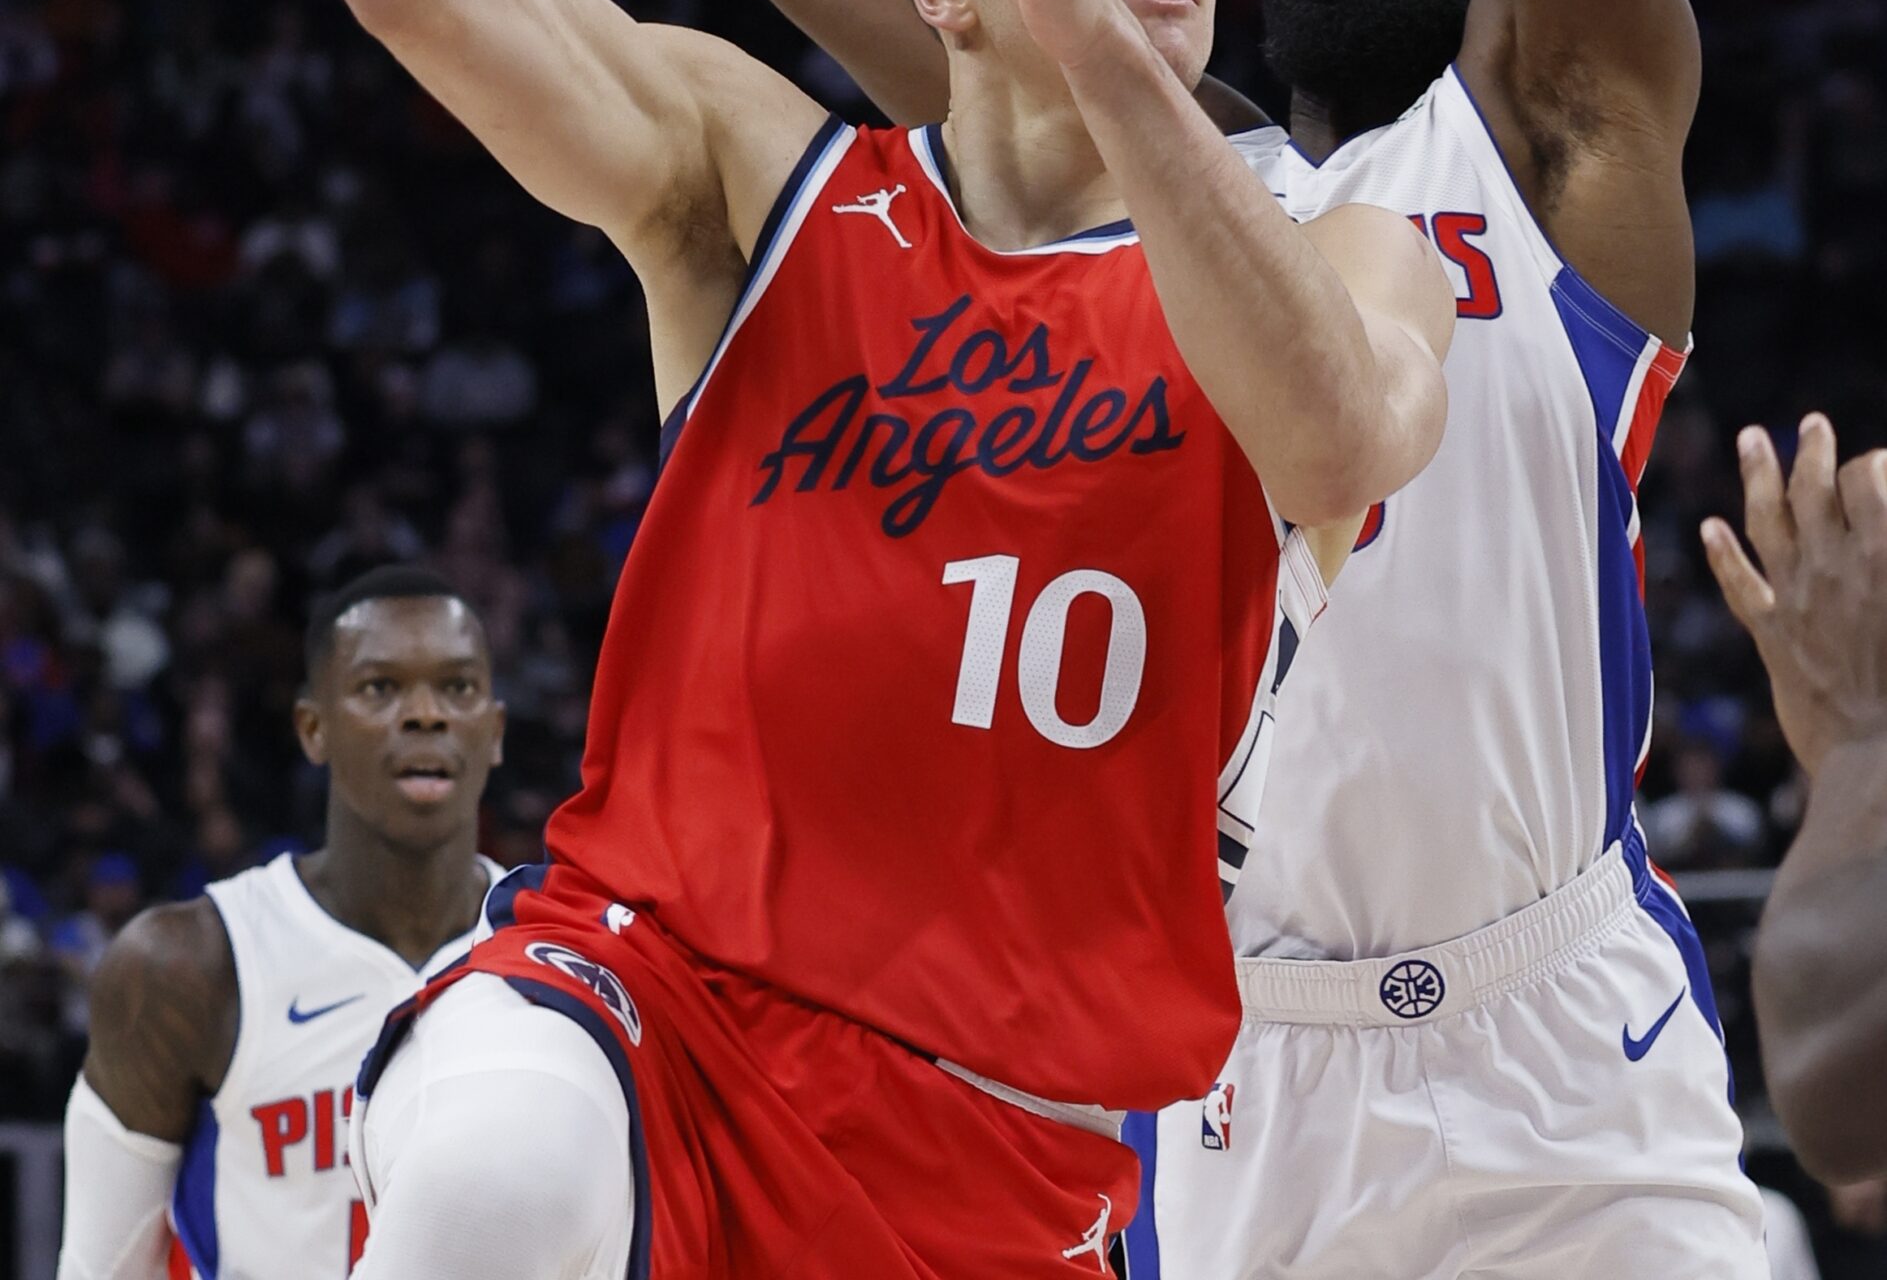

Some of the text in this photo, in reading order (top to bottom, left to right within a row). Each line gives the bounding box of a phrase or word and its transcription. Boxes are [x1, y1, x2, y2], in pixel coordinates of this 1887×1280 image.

[876, 293, 1066, 401] Los
[749, 357, 1187, 539] Angeles
[942, 553, 1148, 750] 10
[250, 1082, 354, 1178] PI
